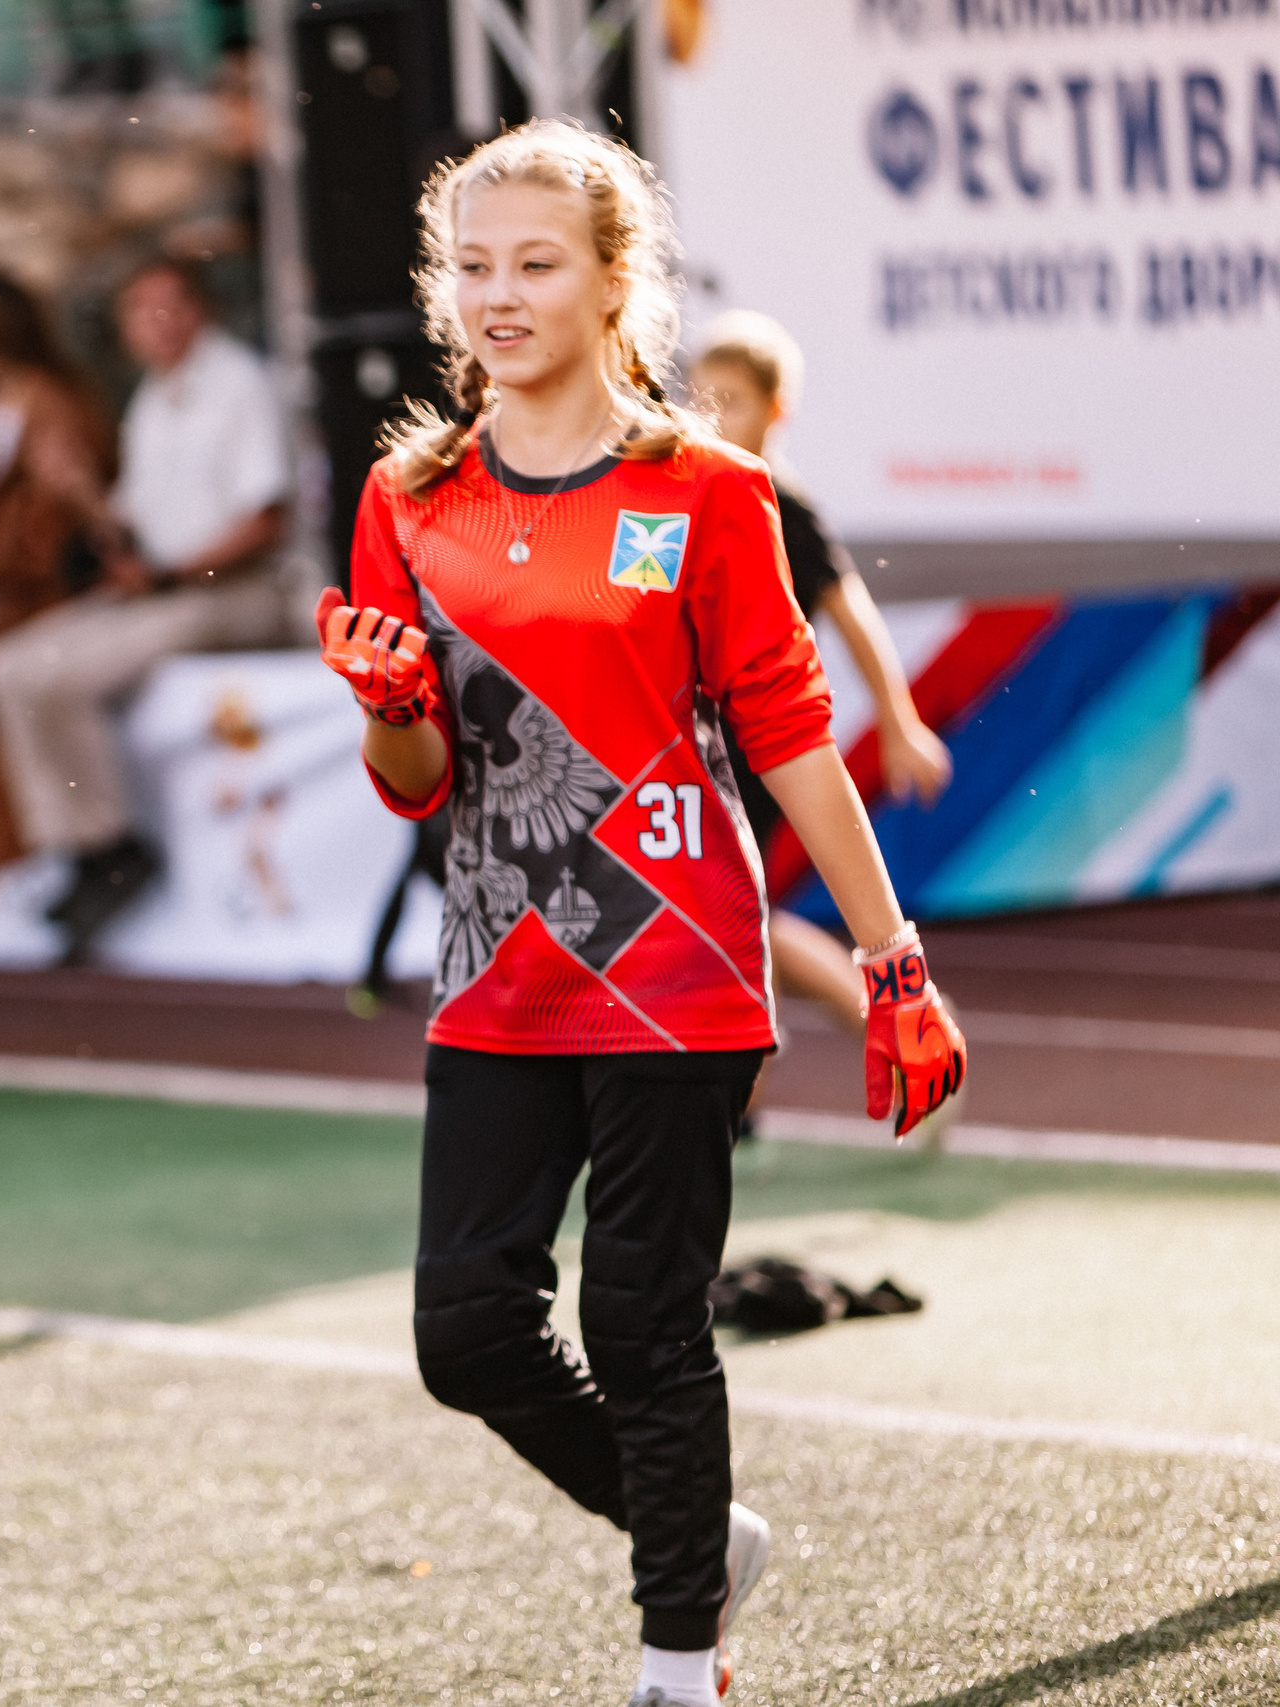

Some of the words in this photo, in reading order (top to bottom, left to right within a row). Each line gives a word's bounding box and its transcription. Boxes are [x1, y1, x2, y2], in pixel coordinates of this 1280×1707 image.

[1141, 247, 1280, 324] ДВОР
[635, 781, 703, 860] 31
[871, 952, 926, 1006] GK
